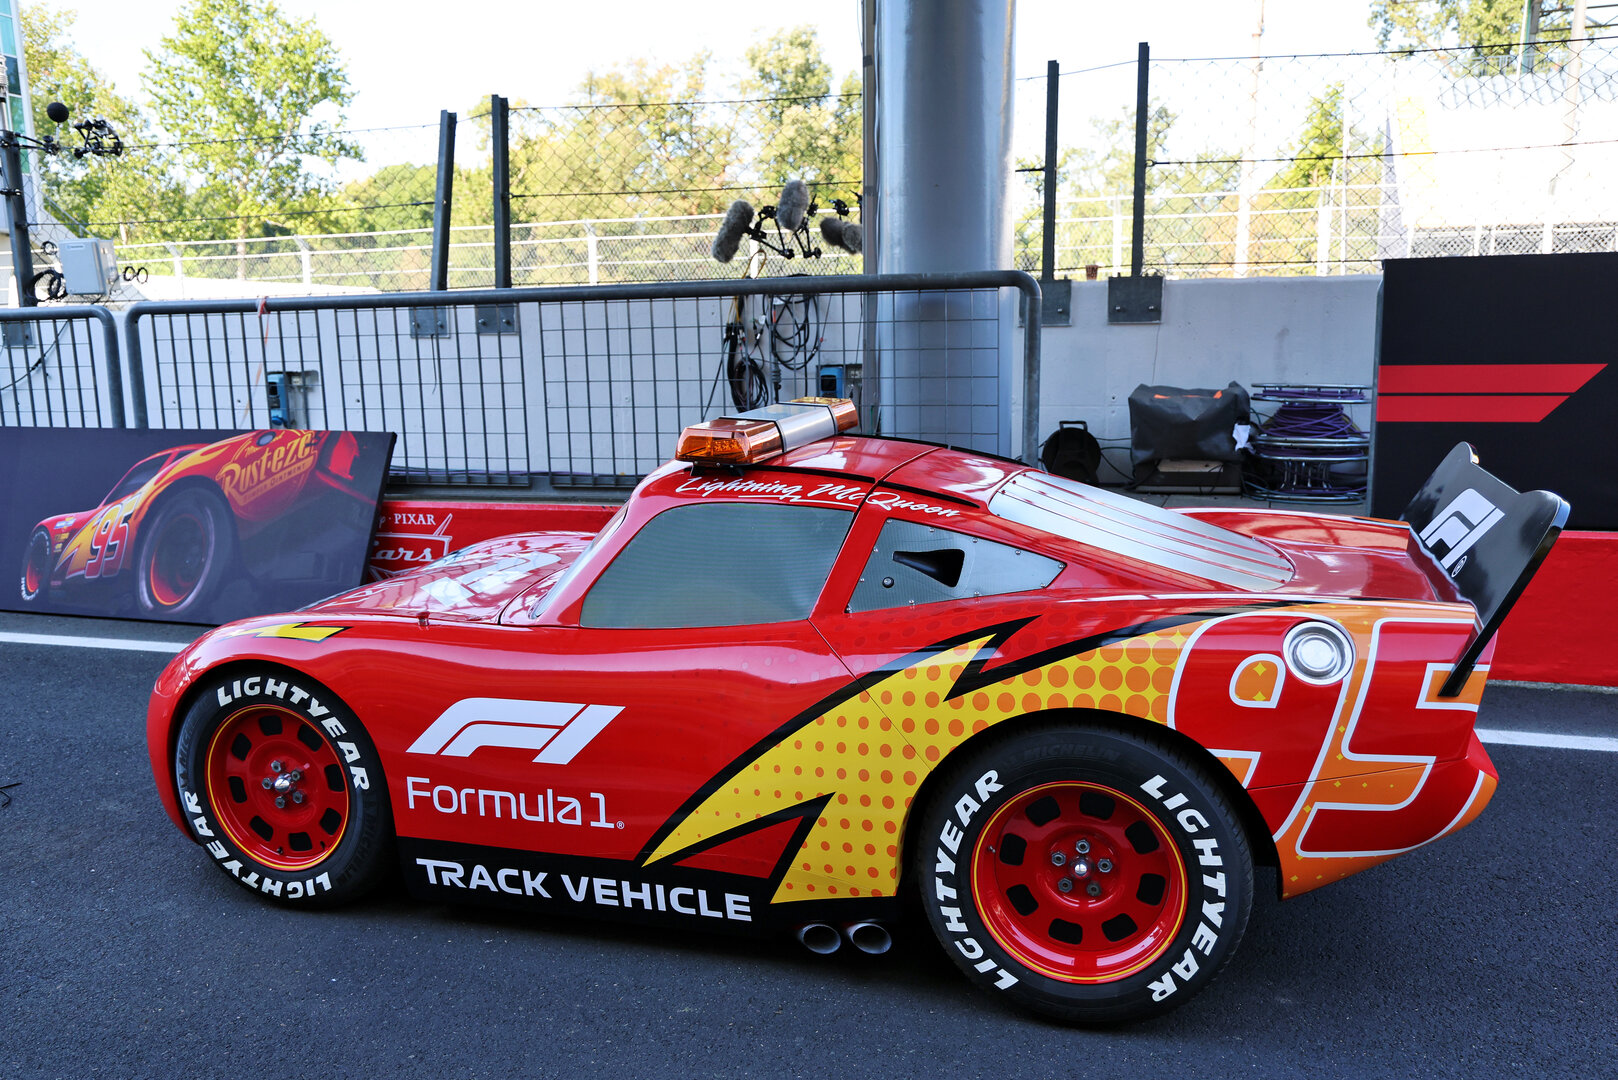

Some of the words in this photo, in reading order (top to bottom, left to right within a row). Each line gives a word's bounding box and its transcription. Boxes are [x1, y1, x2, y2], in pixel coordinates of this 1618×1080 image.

[394, 513, 436, 526] PIXAR
[676, 476, 804, 501] Lightning
[807, 483, 961, 517] McQueen
[84, 494, 140, 579] 95
[372, 541, 436, 562] ars
[217, 675, 370, 790] LIGHTYEAR
[405, 697, 626, 765] F1
[1023, 743, 1121, 762] MICHELIN
[1167, 611, 1488, 858] 95
[184, 791, 332, 898] LIGHTYEAR
[935, 769, 1019, 990] LIGHTYEAR
[415, 857, 552, 898] TRACK
[560, 874, 752, 922] VEHICLE
[1140, 774, 1226, 1002] LIGHTYEAR
